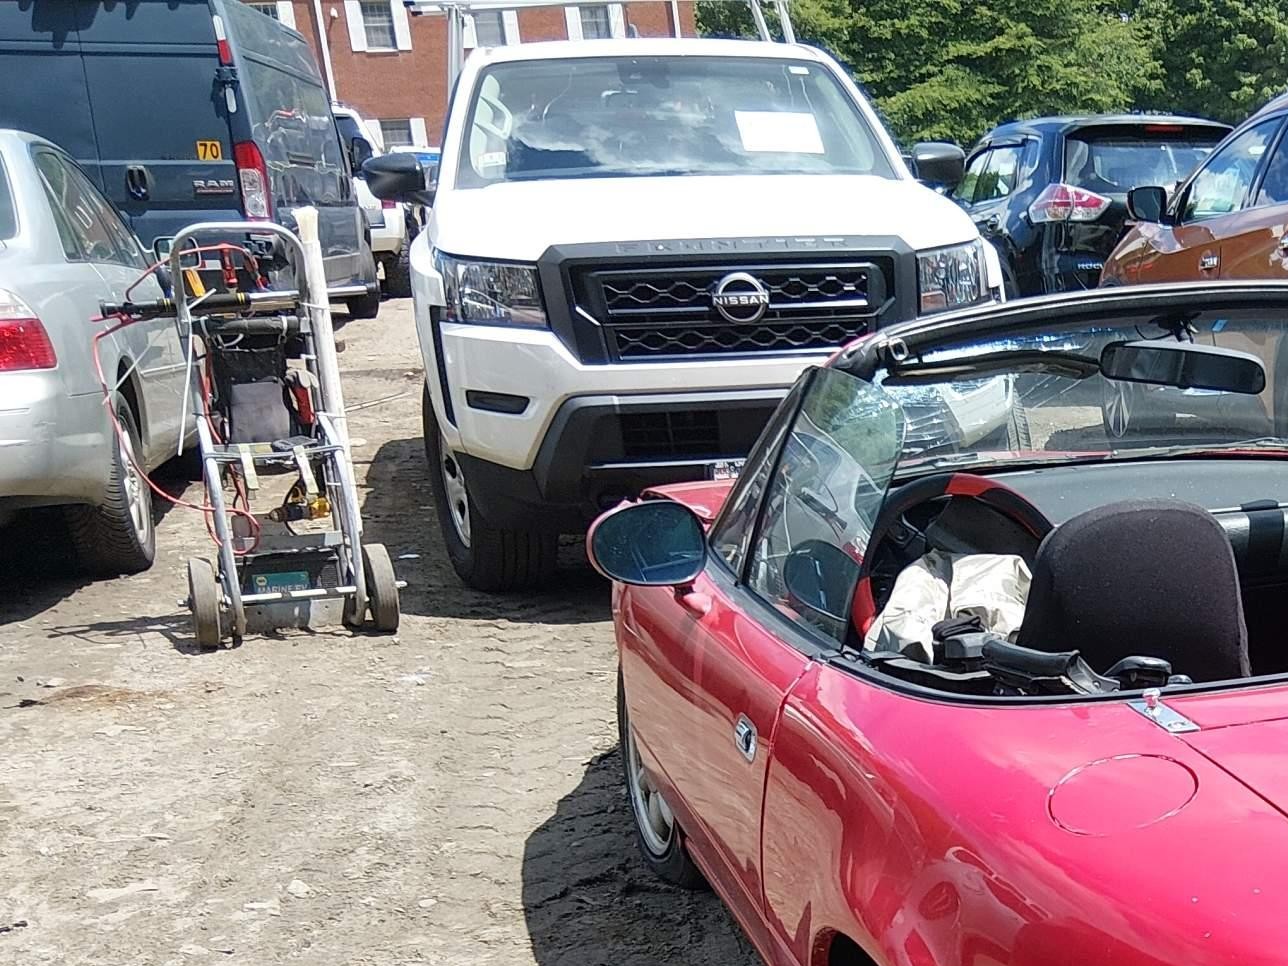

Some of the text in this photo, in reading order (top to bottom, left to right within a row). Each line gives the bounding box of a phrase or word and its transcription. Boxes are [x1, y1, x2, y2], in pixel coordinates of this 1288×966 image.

[199, 142, 219, 160] 70
[193, 180, 234, 188] RAM
[712, 293, 770, 306] NISSAN
